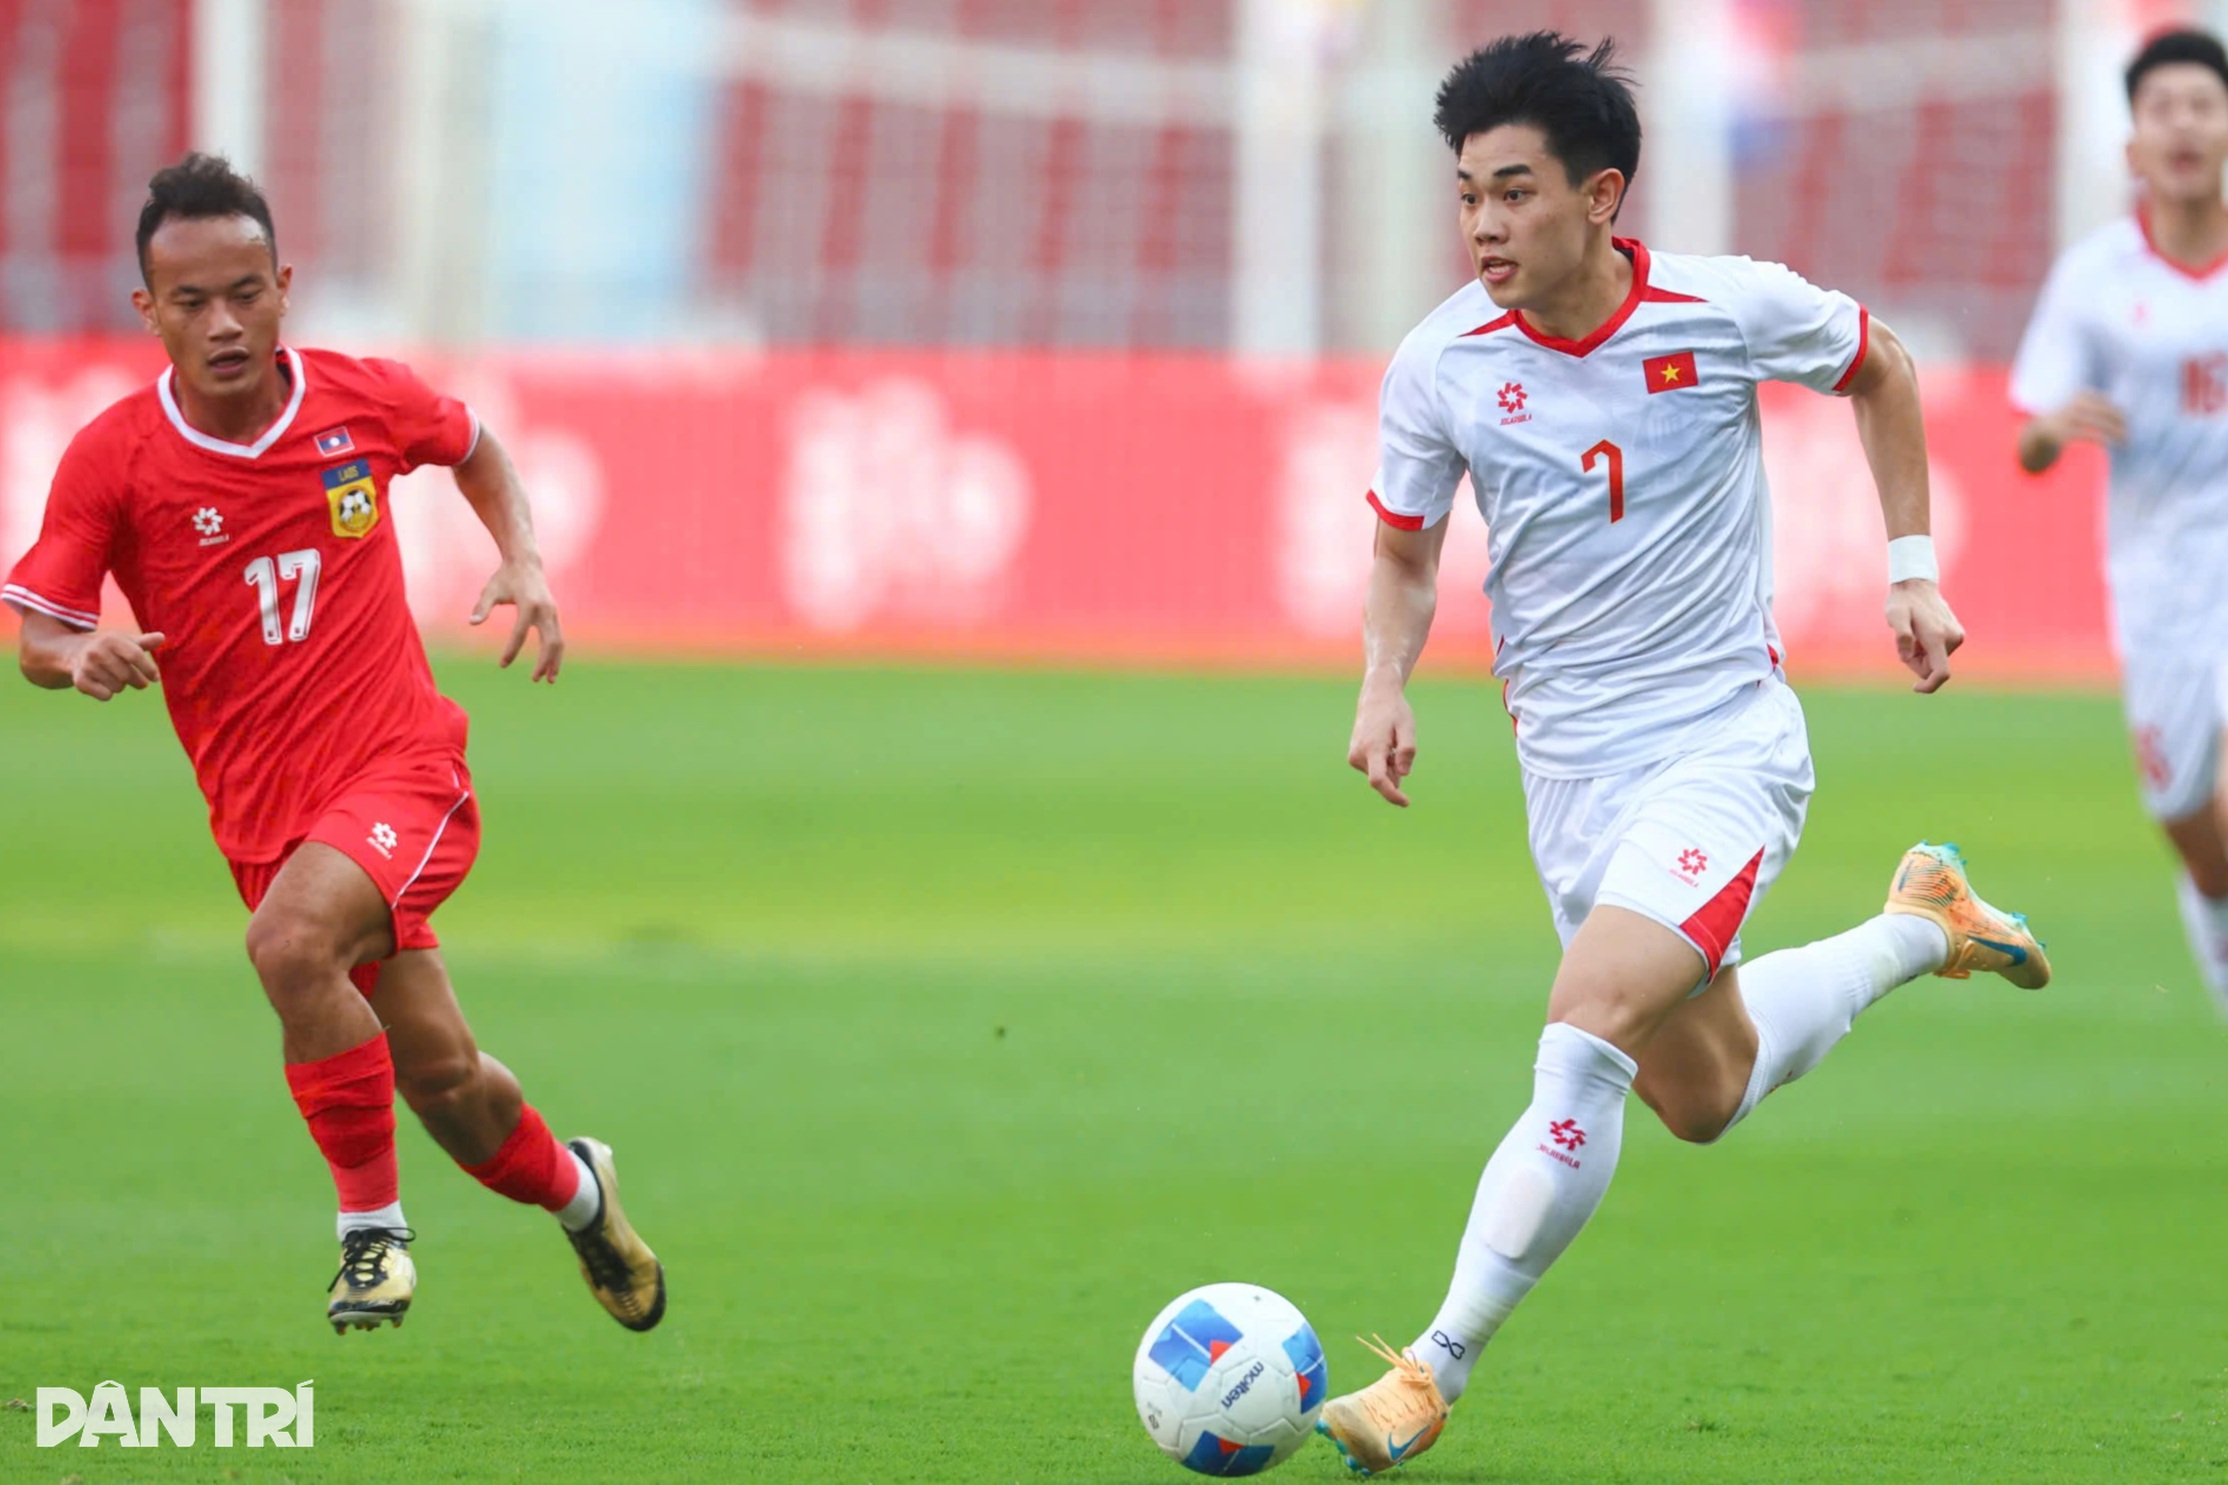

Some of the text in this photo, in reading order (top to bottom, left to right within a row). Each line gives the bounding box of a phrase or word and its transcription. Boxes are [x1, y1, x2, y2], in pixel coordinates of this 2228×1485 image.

[1581, 439, 1624, 525] 7
[244, 548, 322, 646] 17
[1221, 1361, 1264, 1409] molten
